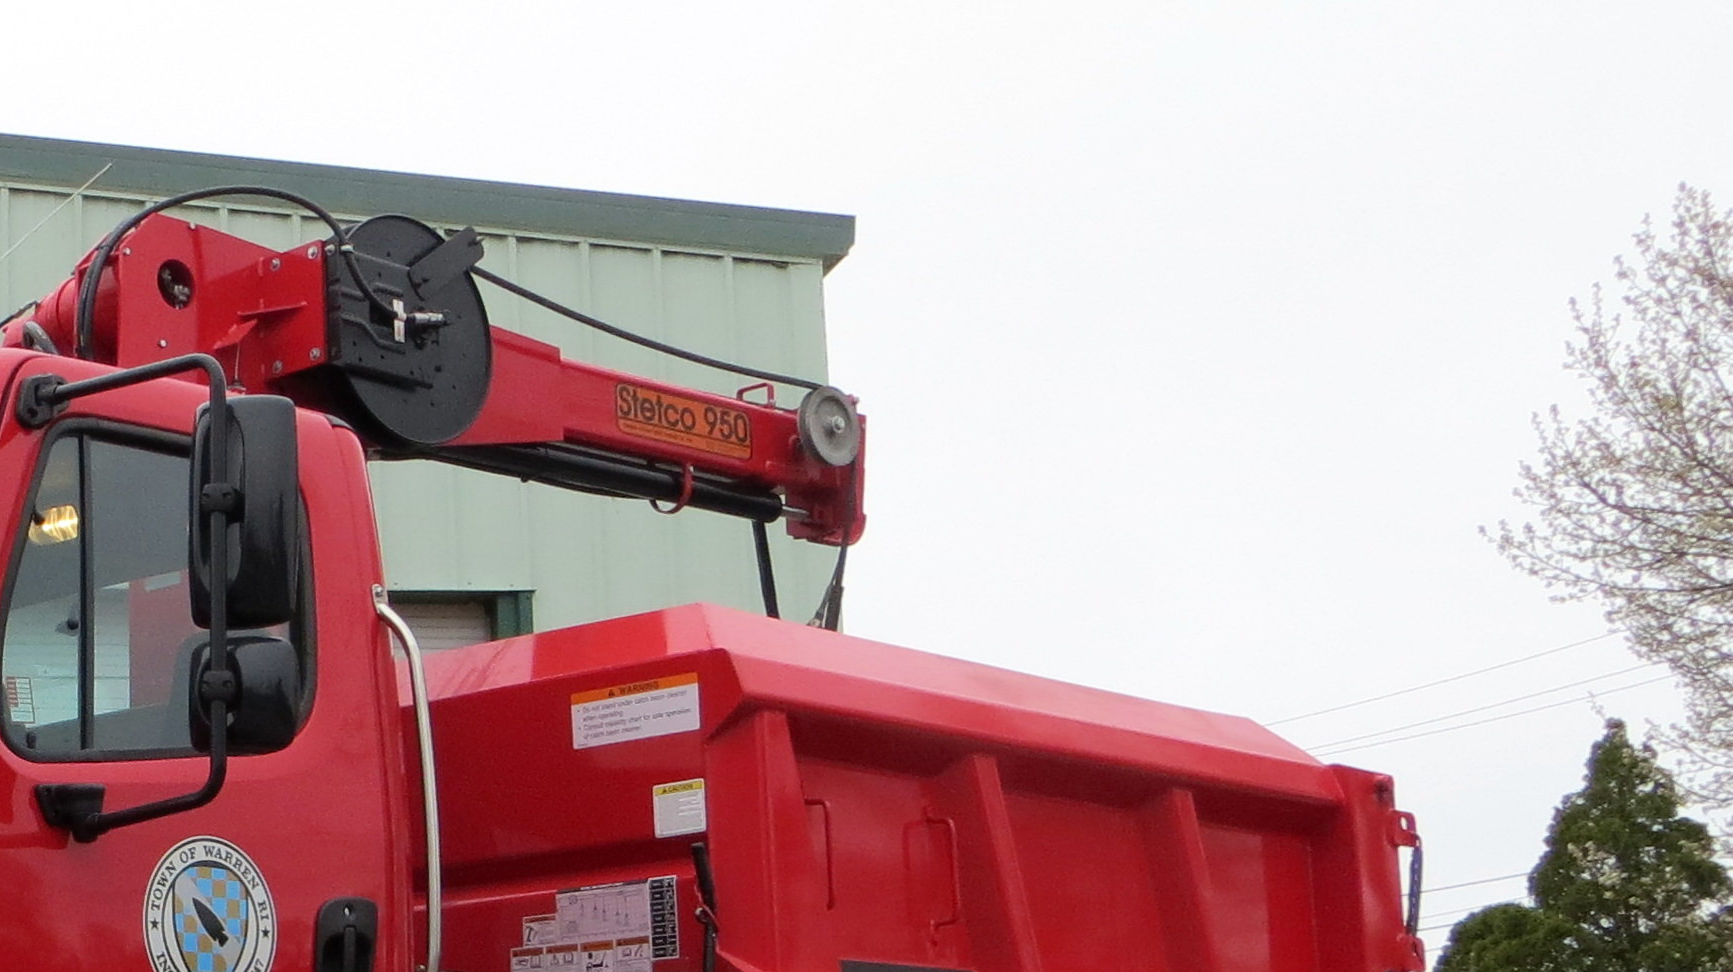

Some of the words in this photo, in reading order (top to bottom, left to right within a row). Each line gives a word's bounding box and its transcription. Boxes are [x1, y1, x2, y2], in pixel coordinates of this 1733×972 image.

[618, 386, 696, 431] Stetco
[704, 406, 748, 443] 950
[619, 680, 659, 695] WARNING
[151, 861, 177, 912] TOWN
[179, 846, 197, 864] OF
[202, 845, 259, 890] WARREN
[258, 899, 269, 921] RI
